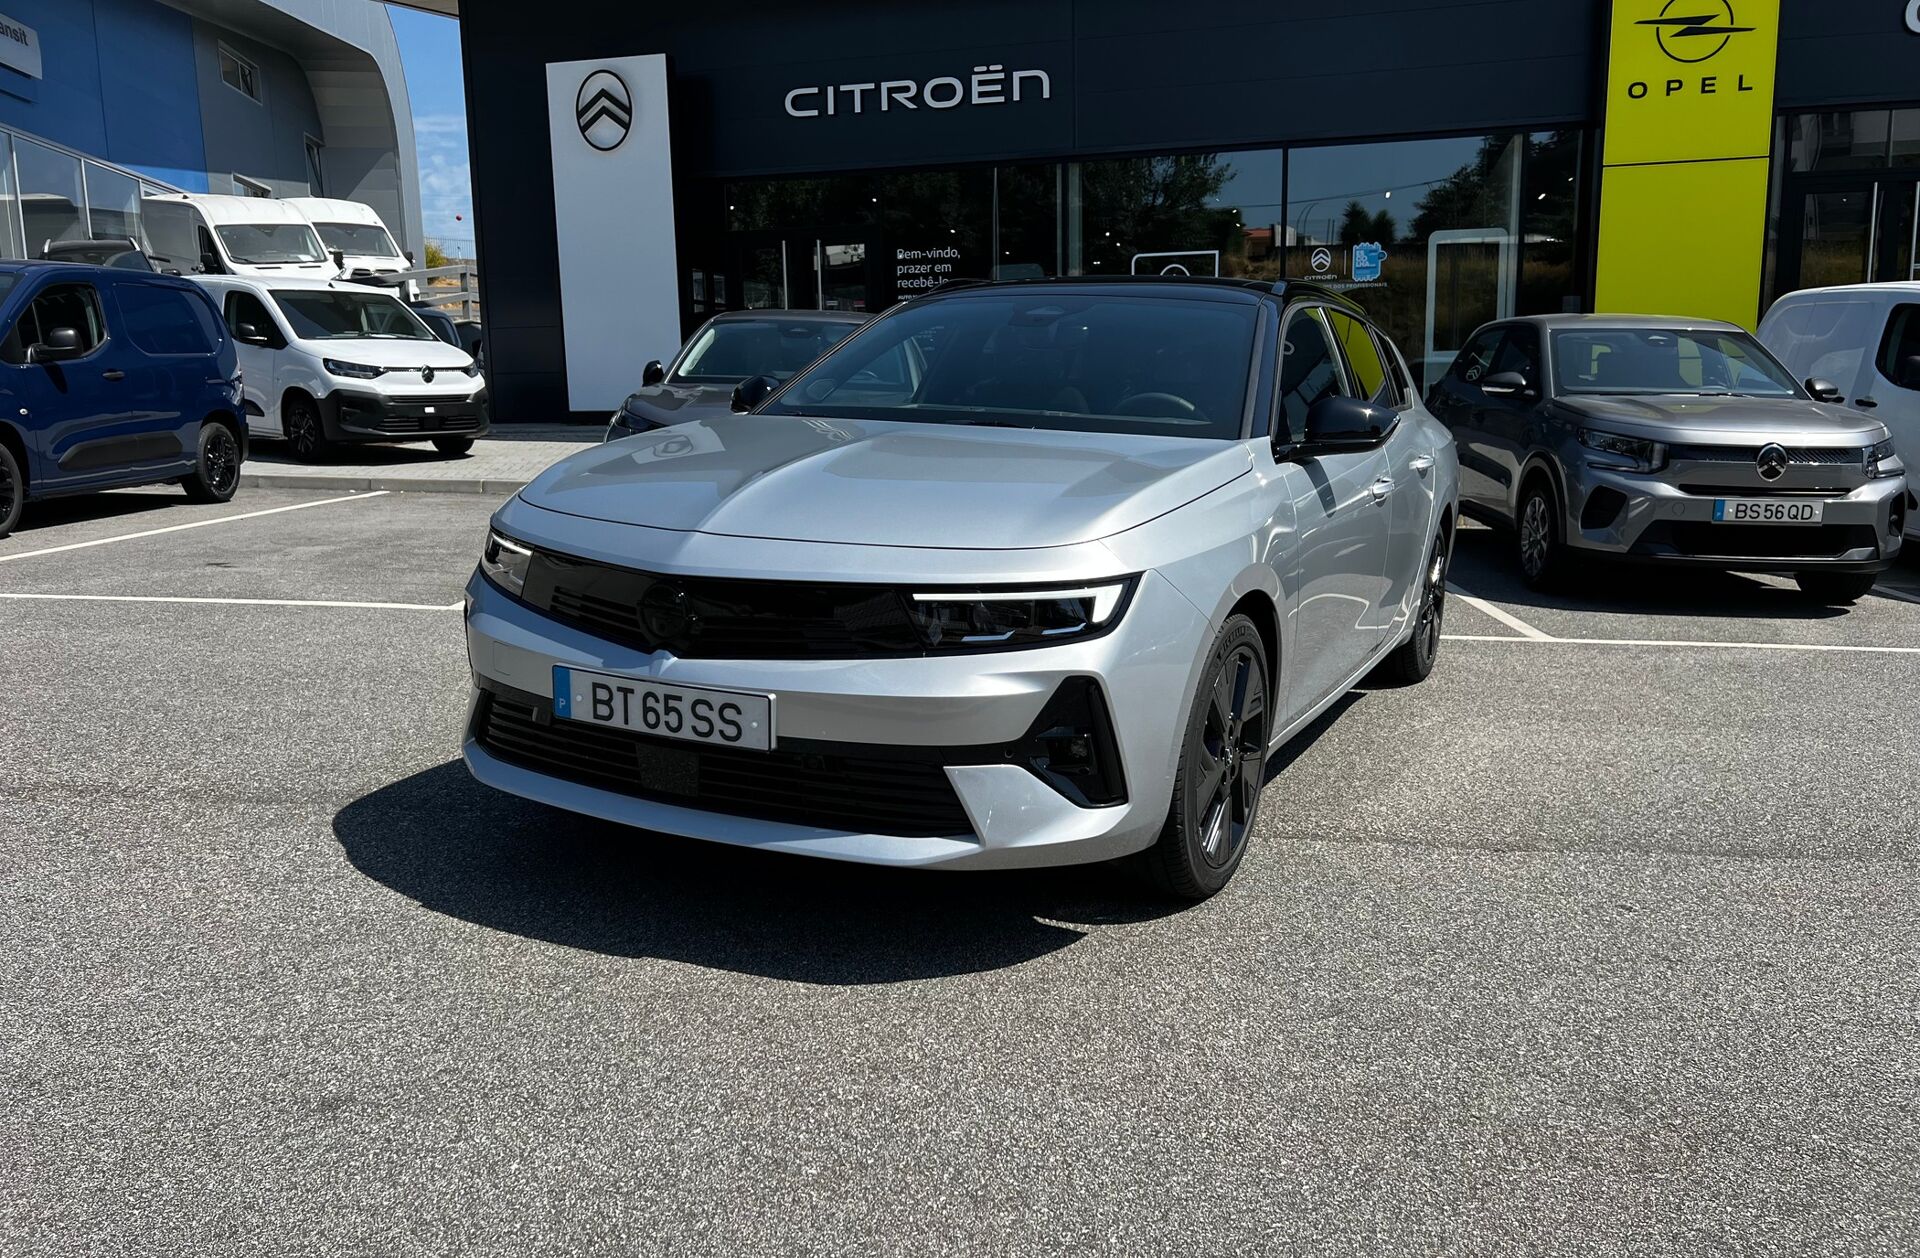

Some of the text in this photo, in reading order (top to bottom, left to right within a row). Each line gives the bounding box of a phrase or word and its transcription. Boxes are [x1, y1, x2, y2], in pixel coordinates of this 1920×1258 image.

[1628, 74, 1753, 100] OPEL
[896, 246, 961, 260] Bem-vindo,
[896, 263, 952, 277] prazer em
[558, 697, 566, 709] P
[592, 682, 743, 742] BT 65 SS
